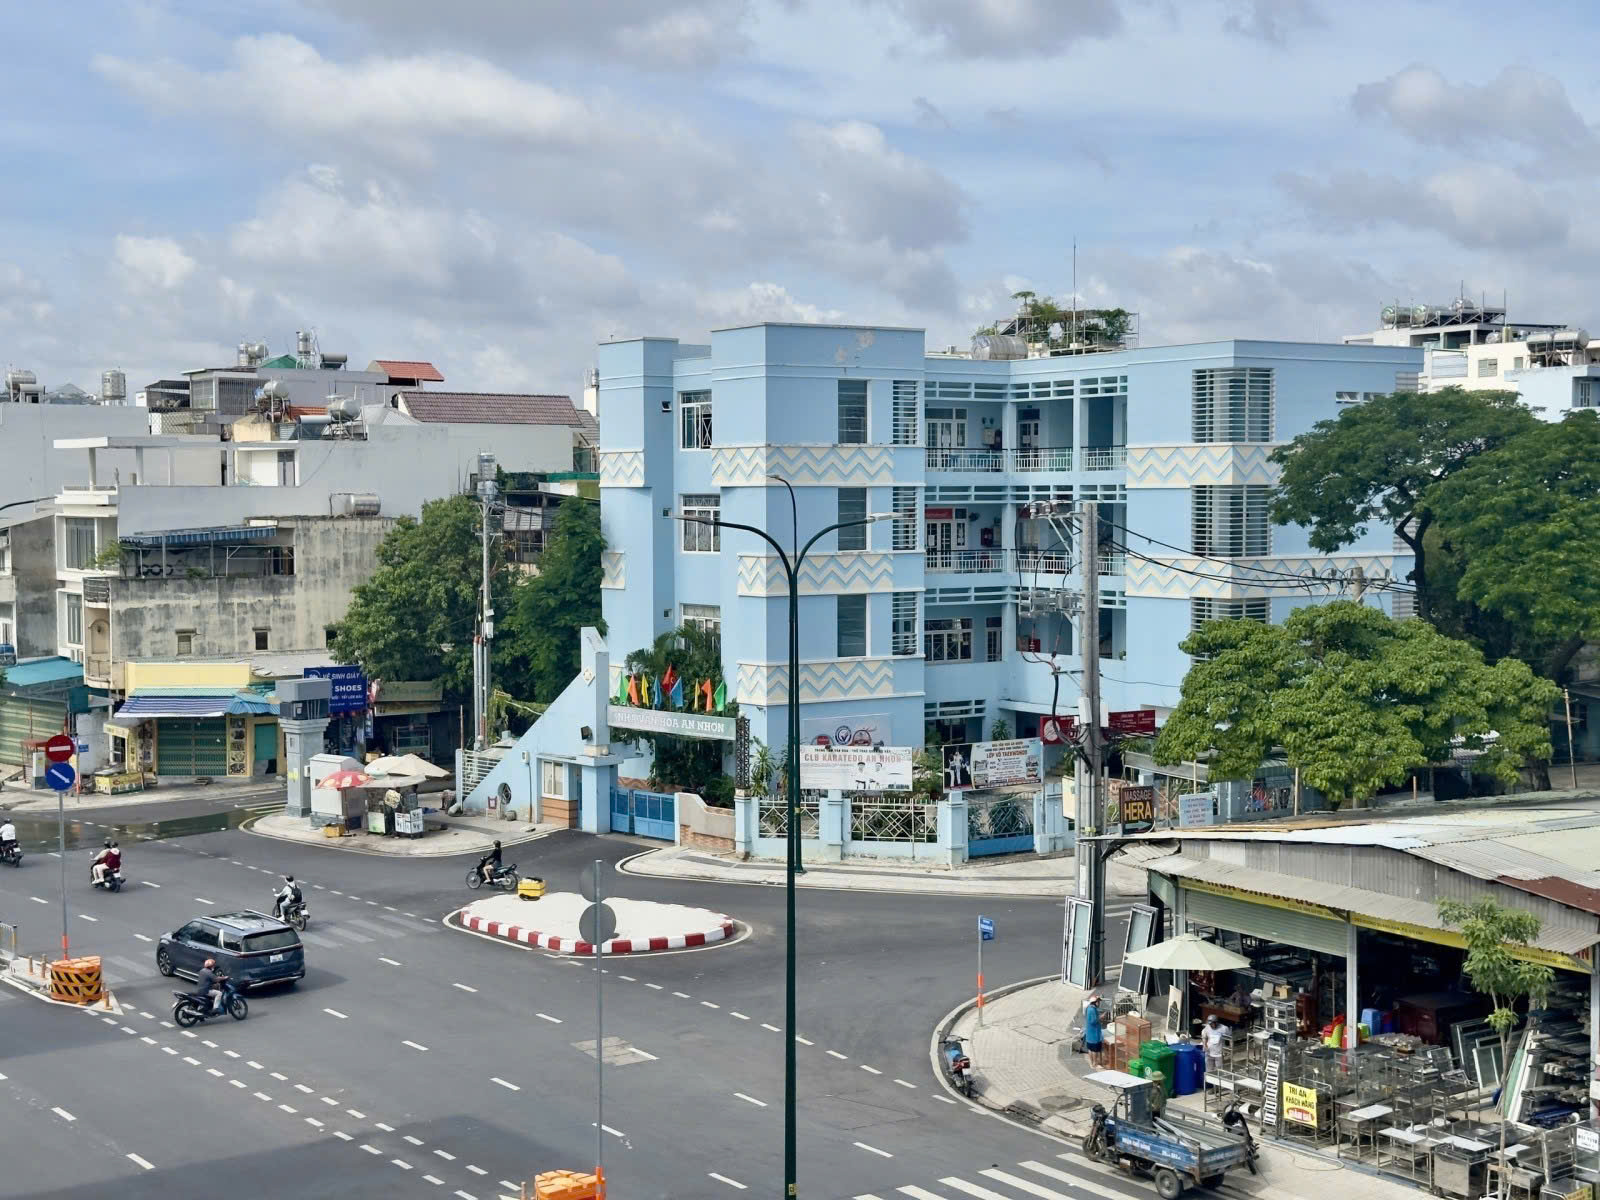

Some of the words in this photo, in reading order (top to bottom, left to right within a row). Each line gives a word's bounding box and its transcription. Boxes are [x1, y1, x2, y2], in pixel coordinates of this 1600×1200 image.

[681, 718, 696, 730] AN
[822, 753, 863, 762] KARATEDO
[865, 753, 878, 762] AN
[1124, 789, 1153, 801] MASSAGE
[1123, 800, 1153, 821] HERA
